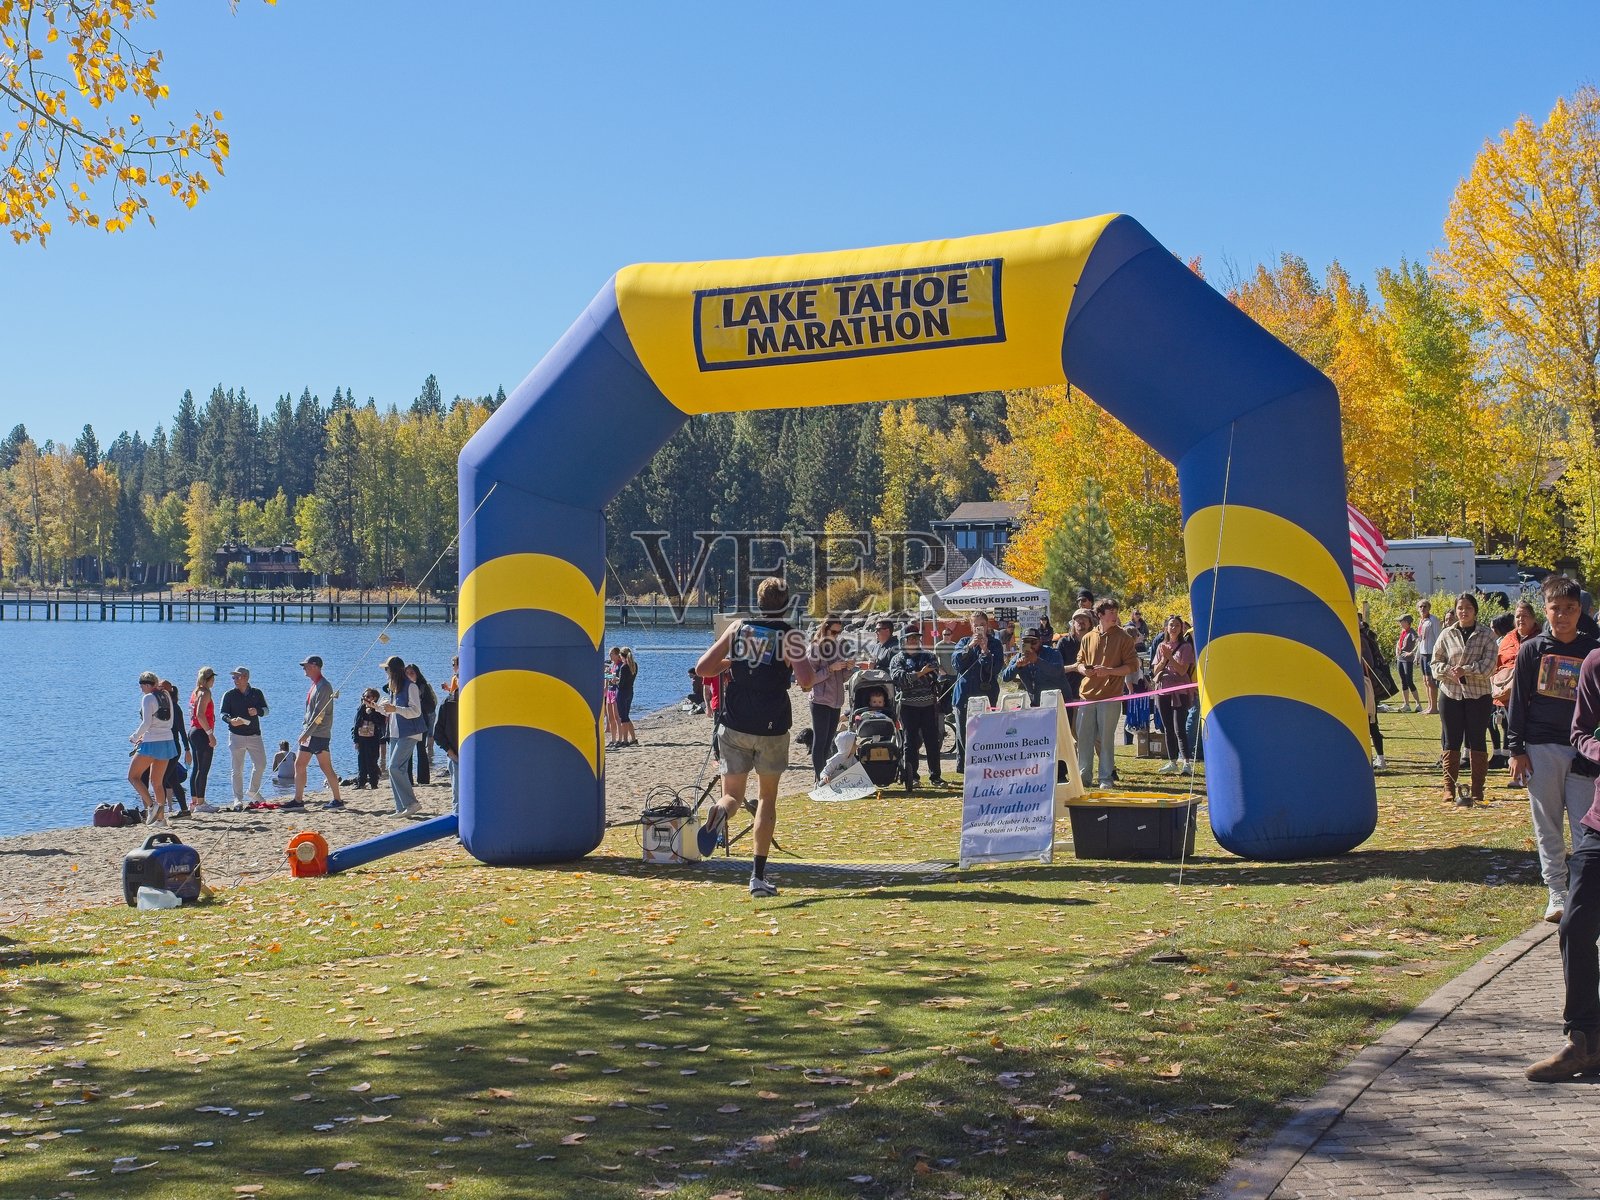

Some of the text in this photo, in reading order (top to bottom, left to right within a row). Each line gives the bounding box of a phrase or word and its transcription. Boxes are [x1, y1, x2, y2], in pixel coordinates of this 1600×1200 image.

[722, 273, 969, 328] LAKE TAHOE
[747, 308, 951, 356] MARATHON
[972, 736, 1050, 752] Commons Beach
[971, 750, 1051, 764] East/West Lawns
[983, 763, 1039, 779] Reserved
[972, 781, 1047, 798] Lake Tahoe
[977, 800, 1040, 816] Marathon
